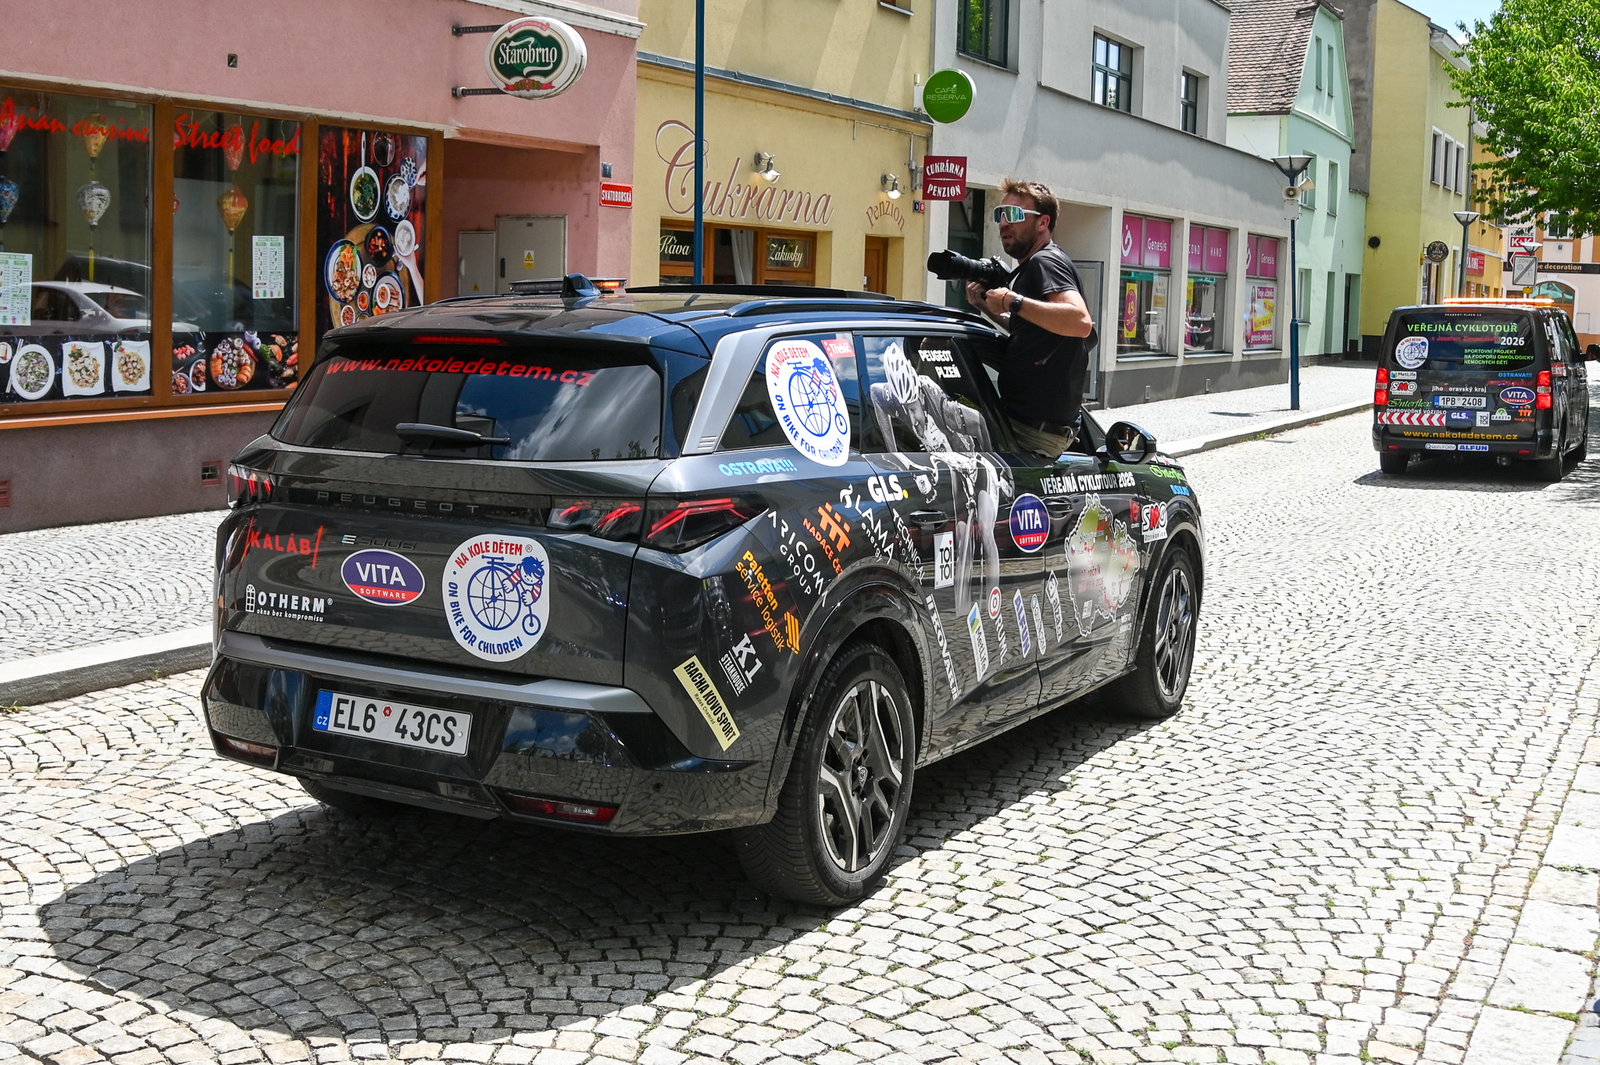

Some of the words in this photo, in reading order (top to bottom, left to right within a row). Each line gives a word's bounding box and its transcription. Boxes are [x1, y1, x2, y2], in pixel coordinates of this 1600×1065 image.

[498, 38, 558, 75] Starobrno
[0, 97, 67, 132] Asian
[73, 116, 150, 143] cuisine
[174, 113, 243, 149] Street
[249, 121, 302, 164] food
[926, 160, 964, 178] CUKRÁRNA
[927, 183, 962, 198] PENZION
[866, 201, 906, 232] Penzion
[659, 234, 692, 257] Káva
[768, 243, 804, 268] Zákusky
[1147, 238, 1167, 252] Genesis
[1210, 247, 1222, 258] HAND
[1544, 263, 1582, 271] decoration
[1407, 322, 1452, 332] VEŘEJNÁ
[1455, 323, 1518, 333] CYKLOTOUR
[1500, 337, 1525, 346] 2026
[774, 347, 789, 364] KOLE
[918, 349, 953, 362] PEUGEOT
[325, 356, 593, 387] www.nakoledetem.cz
[770, 362, 781, 378] NA
[934, 364, 961, 378] PLZEŇ
[1390, 382, 1417, 392] SMO
[1507, 391, 1528, 399] VITA
[1441, 396, 1456, 406] 1PB
[1462, 397, 1483, 407] 2408
[775, 394, 786, 411] ON
[782, 414, 800, 441] BIKE
[800, 438, 816, 457] FOR
[818, 437, 845, 461] CHILDREN
[1403, 430, 1519, 441] www.nakoledetem.cz
[719, 459, 798, 477] OSTRAVA!!!
[1040, 473, 1078, 495] VEŘEJNÁ
[1078, 474, 1119, 492] CYKLOTOUR
[317, 491, 480, 514] PEUGEOT
[1016, 509, 1042, 530] VITA
[1143, 502, 1168, 532] SMO
[803, 518, 834, 560] NADACE
[855, 494, 894, 565] LAMA
[1019, 536, 1043, 545] SOFTWARE
[250, 531, 312, 556] KALÁB
[455, 553, 469, 569] NA
[467, 541, 490, 558] KOLE
[492, 539, 523, 556] DĚTEM
[861, 522, 883, 563] energy
[767, 510, 828, 607] ARICOMA
[780, 544, 812, 595] GROUP
[355, 561, 407, 587] VITA
[743, 550, 779, 611] Paletten
[359, 587, 406, 600] SOFTWARE
[448, 582, 459, 598] ON
[257, 591, 326, 613] OTHERM
[735, 561, 764, 607] service
[761, 604, 786, 650] logistik
[257, 609, 271, 617] okna
[272, 610, 283, 618] bez
[284, 611, 324, 623] kompromisu
[450, 601, 465, 627] BIKE
[1014, 595, 1030, 655] ALFUN
[459, 625, 477, 647] FOR
[478, 636, 523, 655] CHILDREN
[732, 633, 763, 684] K1
[976, 626, 988, 673] MetLife
[721, 653, 746, 694] STEAKHOUSE
[683, 661, 710, 694] RACHA
[702, 690, 723, 716] KOVO
[717, 712, 736, 741] SPORT
[316, 715, 328, 726] CZ
[333, 697, 378, 733] EL6
[394, 708, 457, 747] 43CS
